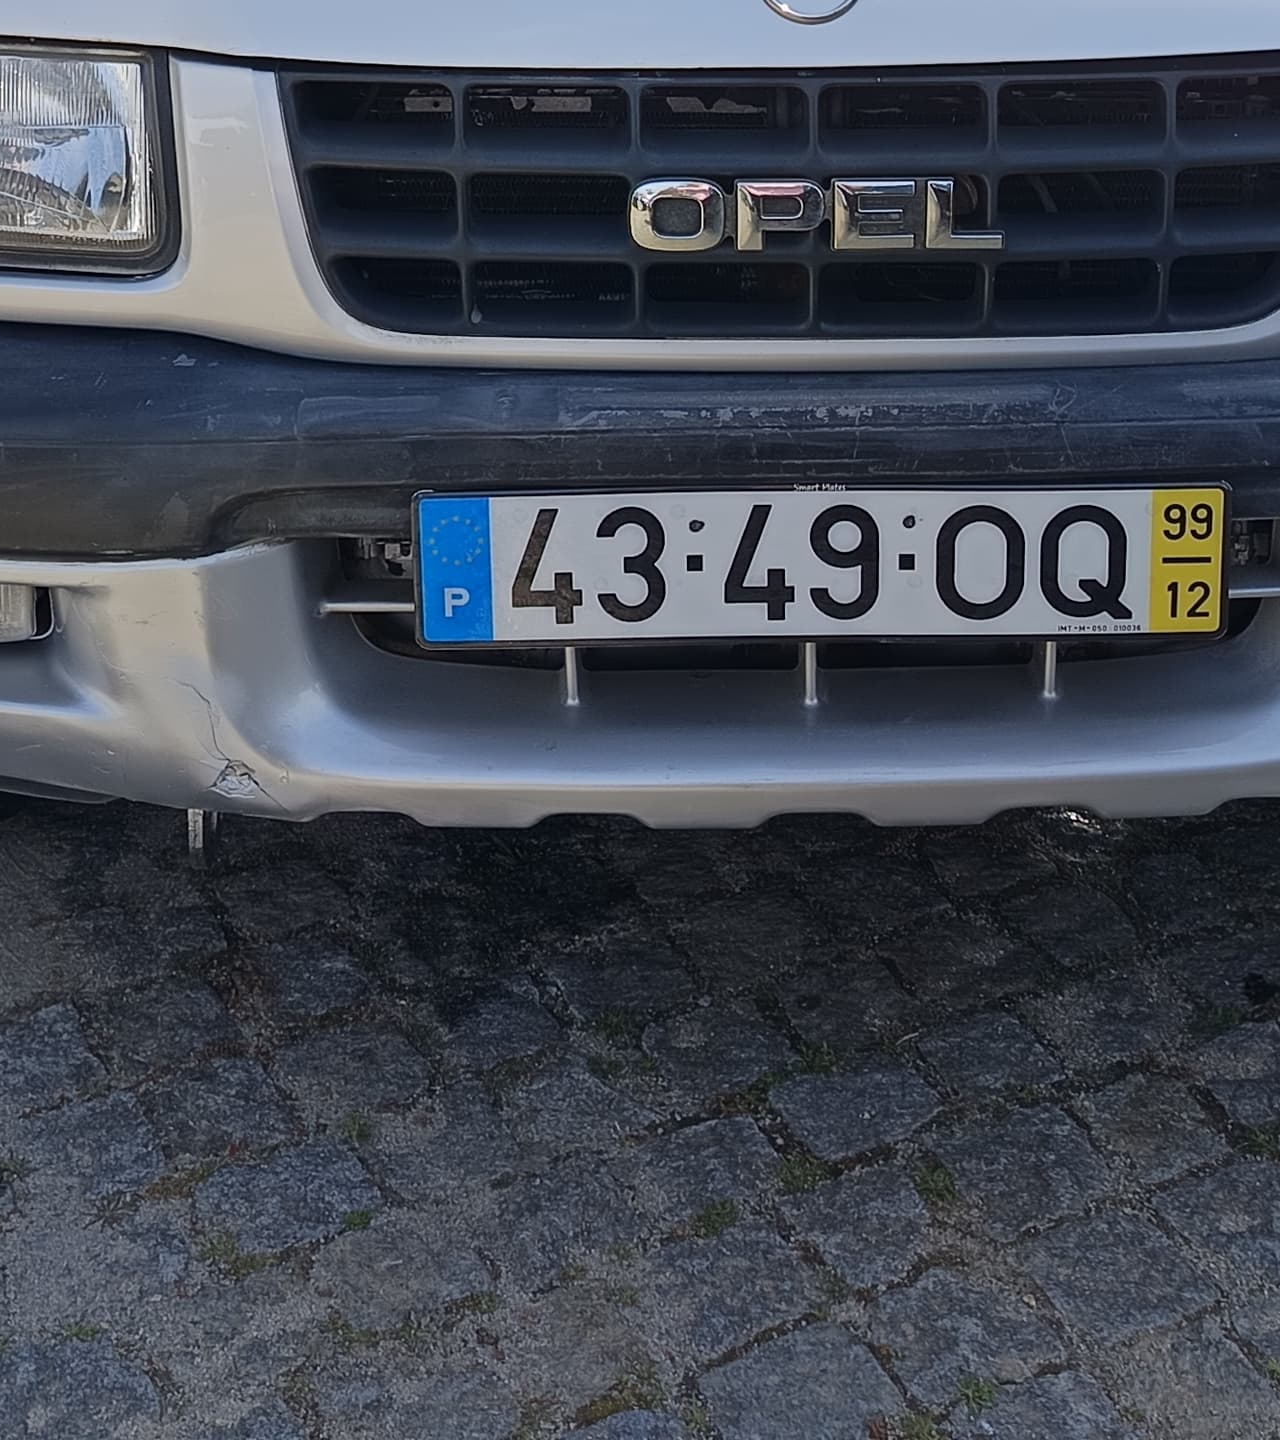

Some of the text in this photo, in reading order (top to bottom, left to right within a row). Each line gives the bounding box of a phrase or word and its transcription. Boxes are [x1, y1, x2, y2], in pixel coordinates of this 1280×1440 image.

[628, 176, 1005, 252] OPEL
[1162, 503, 1214, 541] 99
[443, 587, 470, 618] P
[1166, 581, 1211, 618] 12
